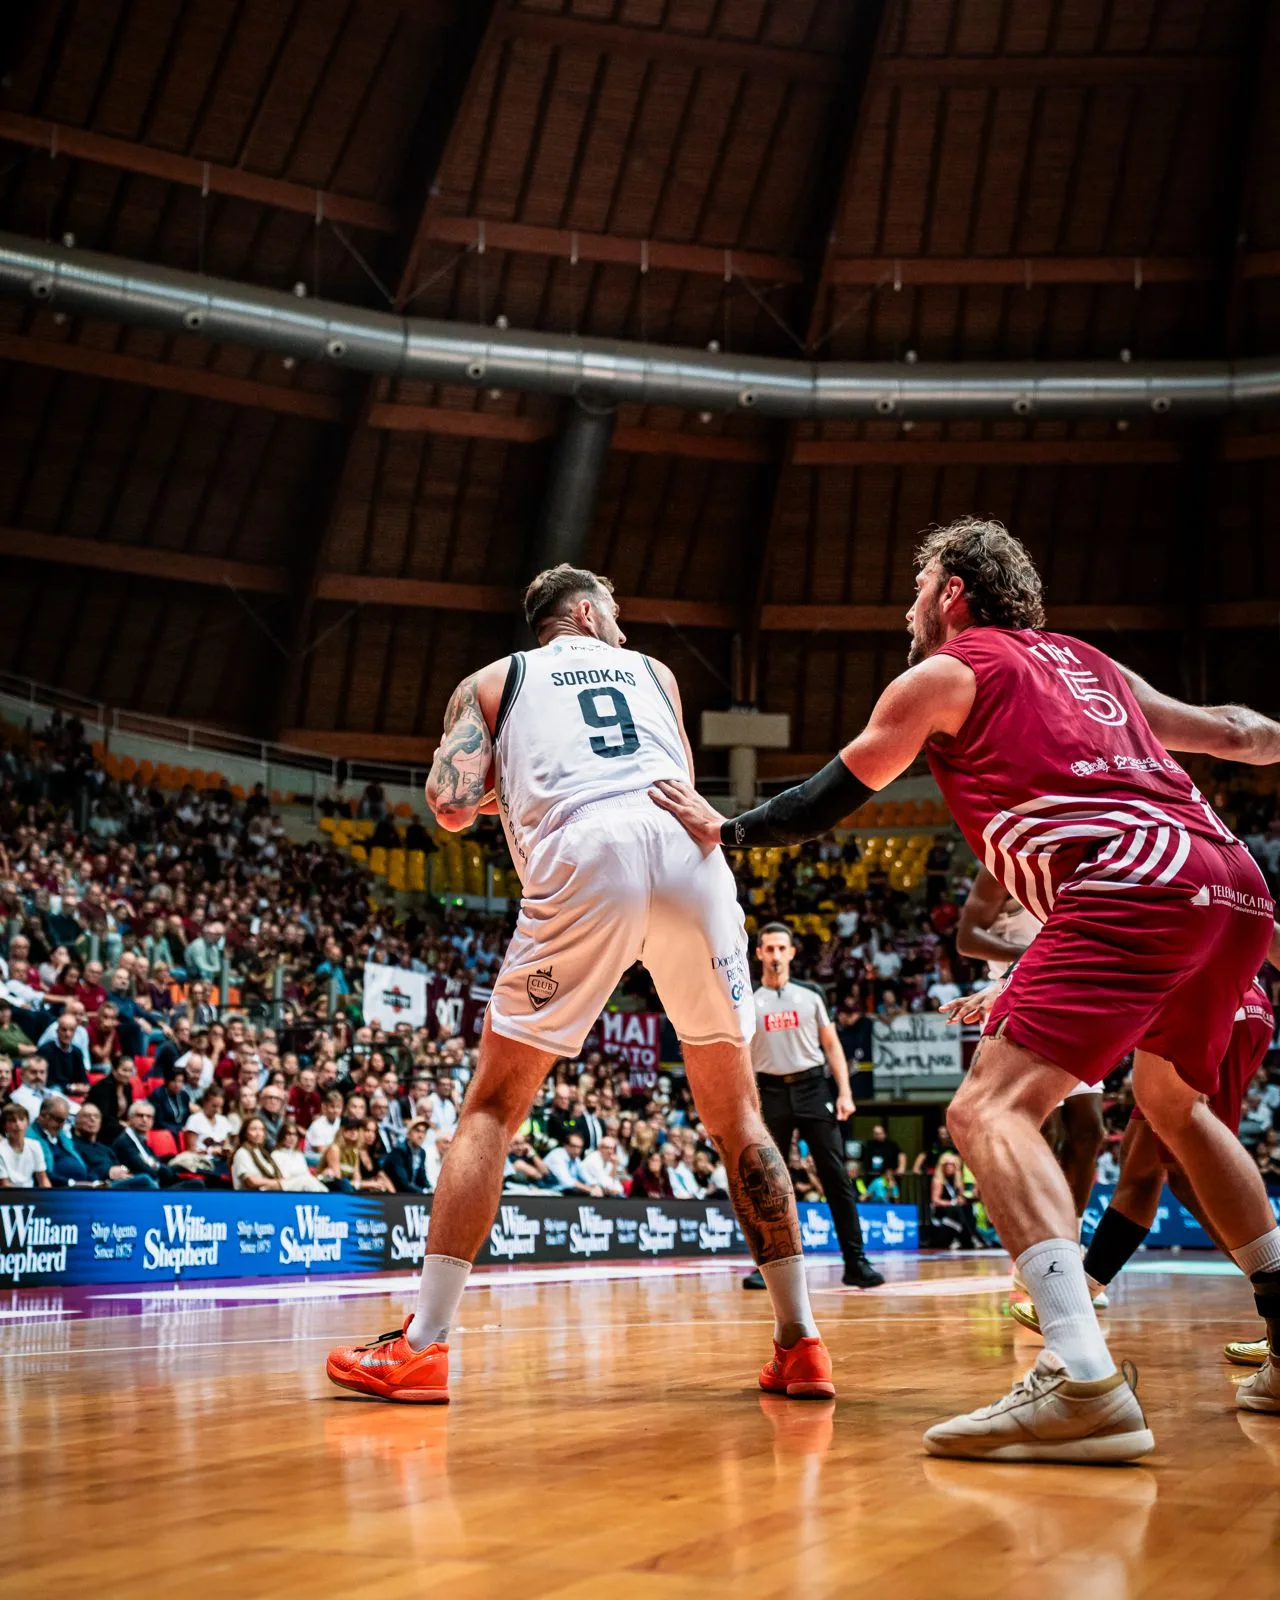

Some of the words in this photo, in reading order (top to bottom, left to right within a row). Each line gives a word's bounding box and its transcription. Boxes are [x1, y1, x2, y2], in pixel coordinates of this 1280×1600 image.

[551, 669, 636, 687] SOROKAS
[1056, 667, 1128, 727] 5
[577, 686, 641, 759] 9
[531, 978, 553, 991] CLUB
[602, 1011, 656, 1046] MAI
[0, 1205, 79, 1248] William
[91, 1222, 110, 1242] Ship
[111, 1224, 138, 1242] Agents
[163, 1204, 228, 1243] William
[295, 1204, 349, 1239] William
[500, 1205, 541, 1236] William
[94, 1244, 114, 1259] Since
[143, 1227, 219, 1274] Shepherd
[279, 1225, 342, 1268] Shepherd
[489, 1222, 536, 1260] Shepherd
[0, 1245, 67, 1282] epherd
